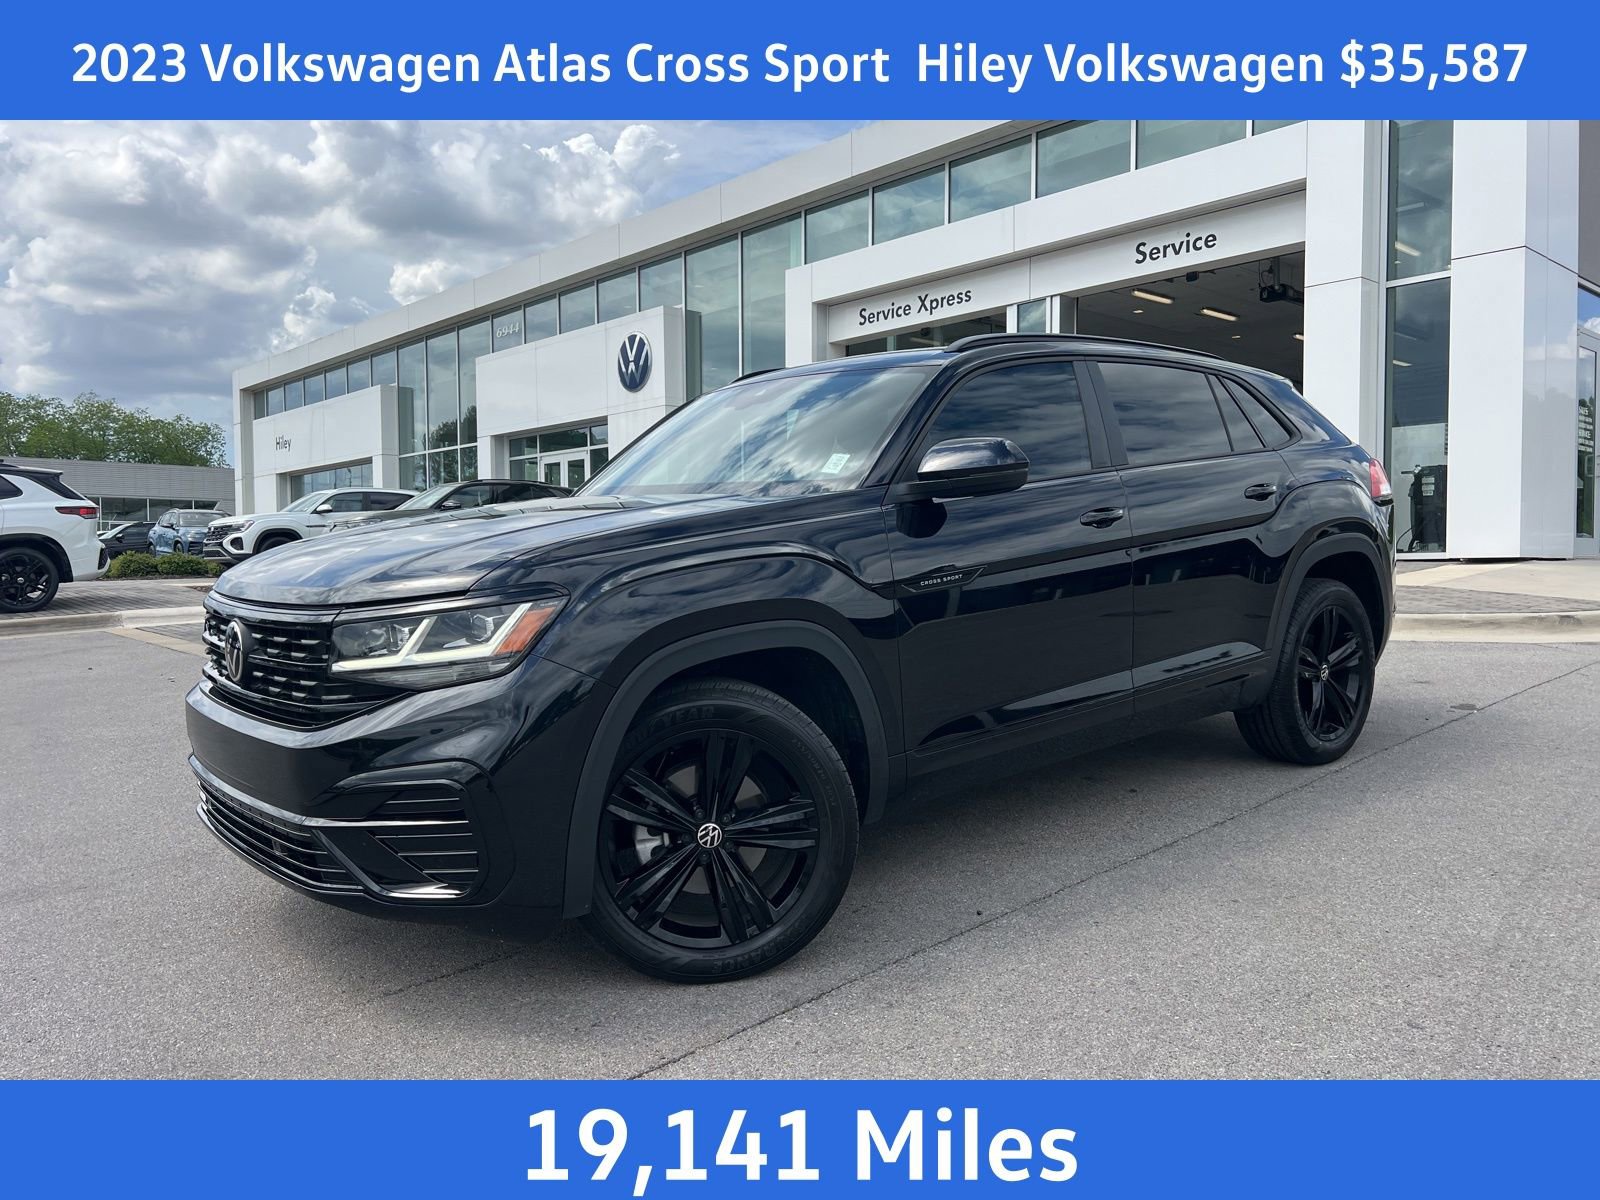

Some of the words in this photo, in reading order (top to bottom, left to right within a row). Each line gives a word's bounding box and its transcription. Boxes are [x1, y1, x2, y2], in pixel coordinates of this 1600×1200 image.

[1135, 232, 1217, 264] Service
[858, 301, 912, 326] Service
[917, 290, 972, 315] Xpress
[496, 321, 519, 338] 6944
[275, 435, 292, 452] Hiley
[920, 578, 941, 586] CROSS
[943, 574, 962, 582] SPORT
